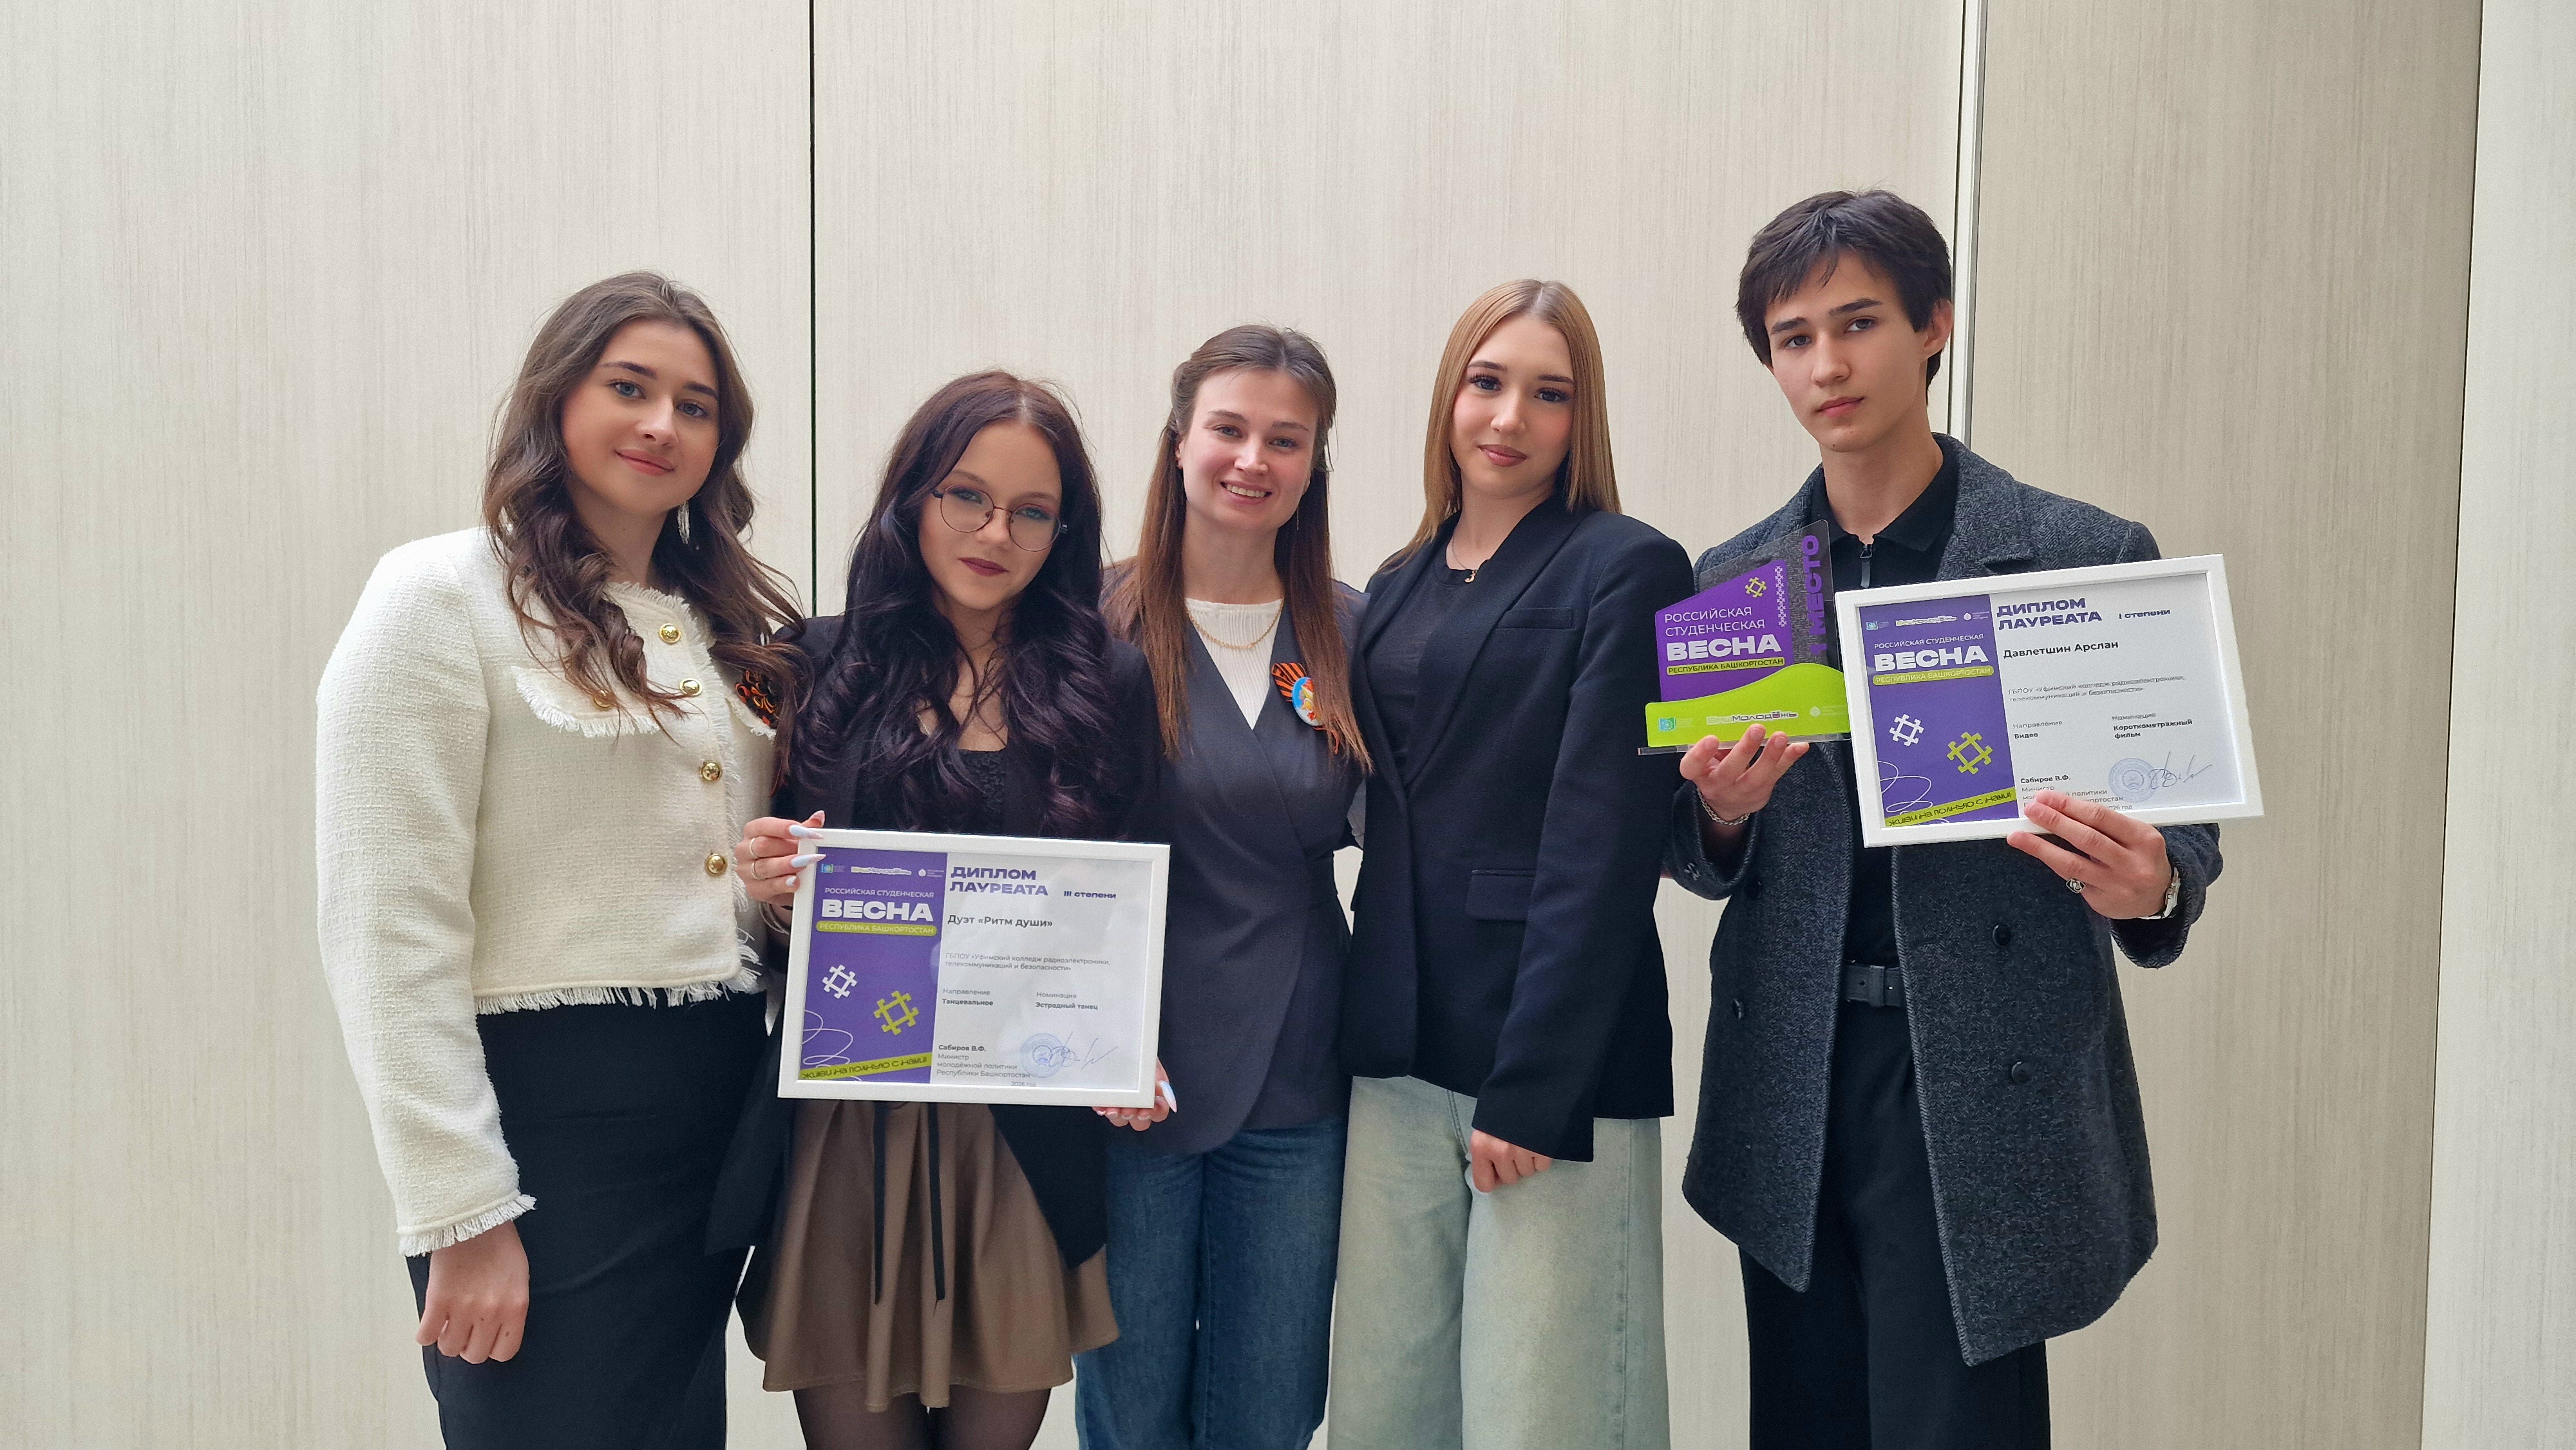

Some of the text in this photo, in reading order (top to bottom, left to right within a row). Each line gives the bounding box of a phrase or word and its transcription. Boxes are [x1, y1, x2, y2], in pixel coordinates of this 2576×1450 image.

[1802, 534, 1826, 636] МЕСТО
[1664, 607, 1752, 623] РОССИЙСКАЯ
[1996, 598, 2086, 617] ДИПЛОМ
[2124, 609, 2171, 619] степени
[1665, 619, 1765, 637] СТУДЕНЧЕСКАЯ
[1998, 611, 2103, 630] ЛАУРЕАТА
[1666, 634, 1782, 661] ВЕСНА
[1874, 634, 1984, 649] РОССИЙСКАЯ СТУДЕНЧЕСКАЯ
[2003, 641, 2119, 659] Давлетшин Арслан
[1668, 658, 1783, 673] РЕСПУБЛИКА БАШКОРТОСТАН
[1873, 645, 1989, 672] ВЕСНА
[1876, 668, 1991, 684] РЕСПУБЛИКА БАШКОРТОСТАН
[2012, 720, 2063, 730] Направление
[2113, 719, 2193, 731] Короткометражный
[2114, 731, 2141, 740] фильм
[951, 867, 1036, 881] ДИПЛОМ
[824, 887, 934, 898] РОССИЙСКАЯ СТУДЕНЧЕСКАЯ
[949, 881, 1048, 896] ЛАУРЕАТА
[821, 899, 934, 922] ВЕСНА
[819, 923, 934, 934] РЕСПУБЛИКА БАШКОРТОСТАН
[947, 915, 1053, 928] Дуэт «Ритм души»
[943, 988, 990, 997] Направление
[1036, 1001, 1076, 1010] Эстрадный
